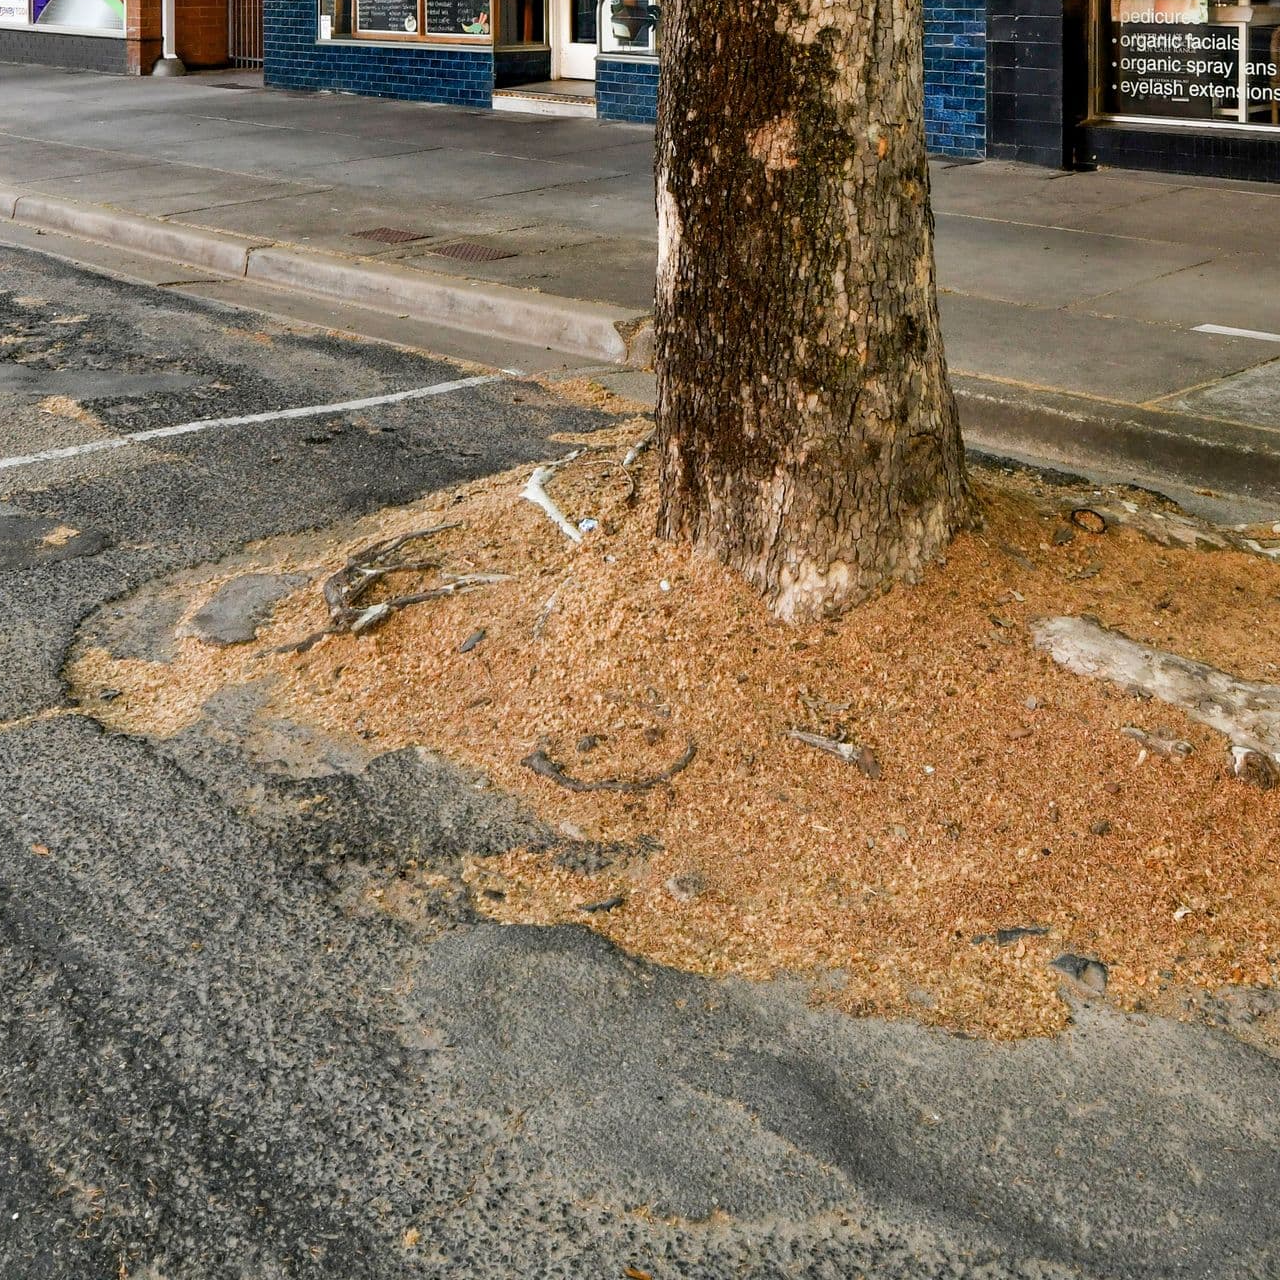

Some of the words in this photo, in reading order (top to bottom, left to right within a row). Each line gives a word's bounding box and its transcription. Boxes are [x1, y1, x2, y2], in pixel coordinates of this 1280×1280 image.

[1120, 34, 1182, 52] organic
[1186, 33, 1240, 51] facials
[1120, 56, 1182, 74] organic
[1186, 60, 1233, 78] spray
[1241, 62, 1278, 76] ans
[1120, 79, 1183, 97] eyelash
